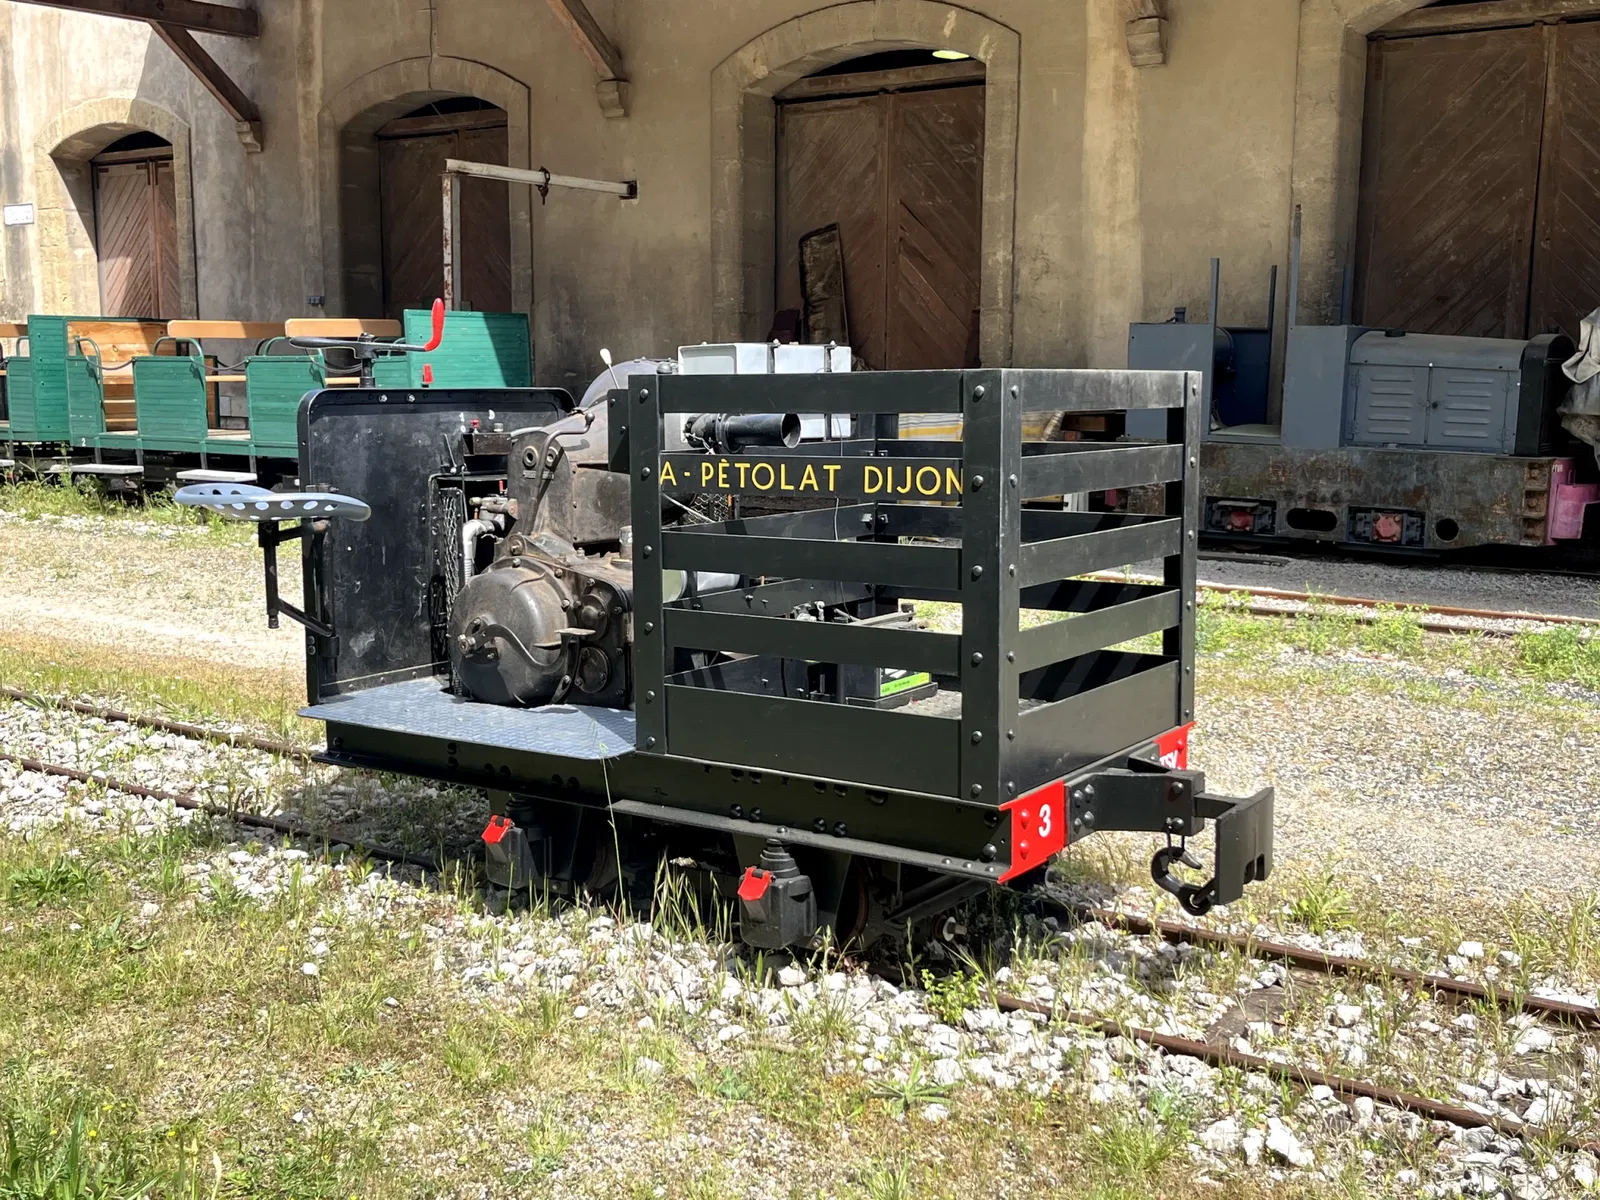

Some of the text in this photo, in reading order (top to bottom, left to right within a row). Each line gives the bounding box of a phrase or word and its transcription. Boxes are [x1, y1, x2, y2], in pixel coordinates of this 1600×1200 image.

[81, 437, 87, 447] 2
[659, 461, 677, 486] A
[864, 465, 963, 496] DIJON
[1038, 803, 1051, 838] 3
